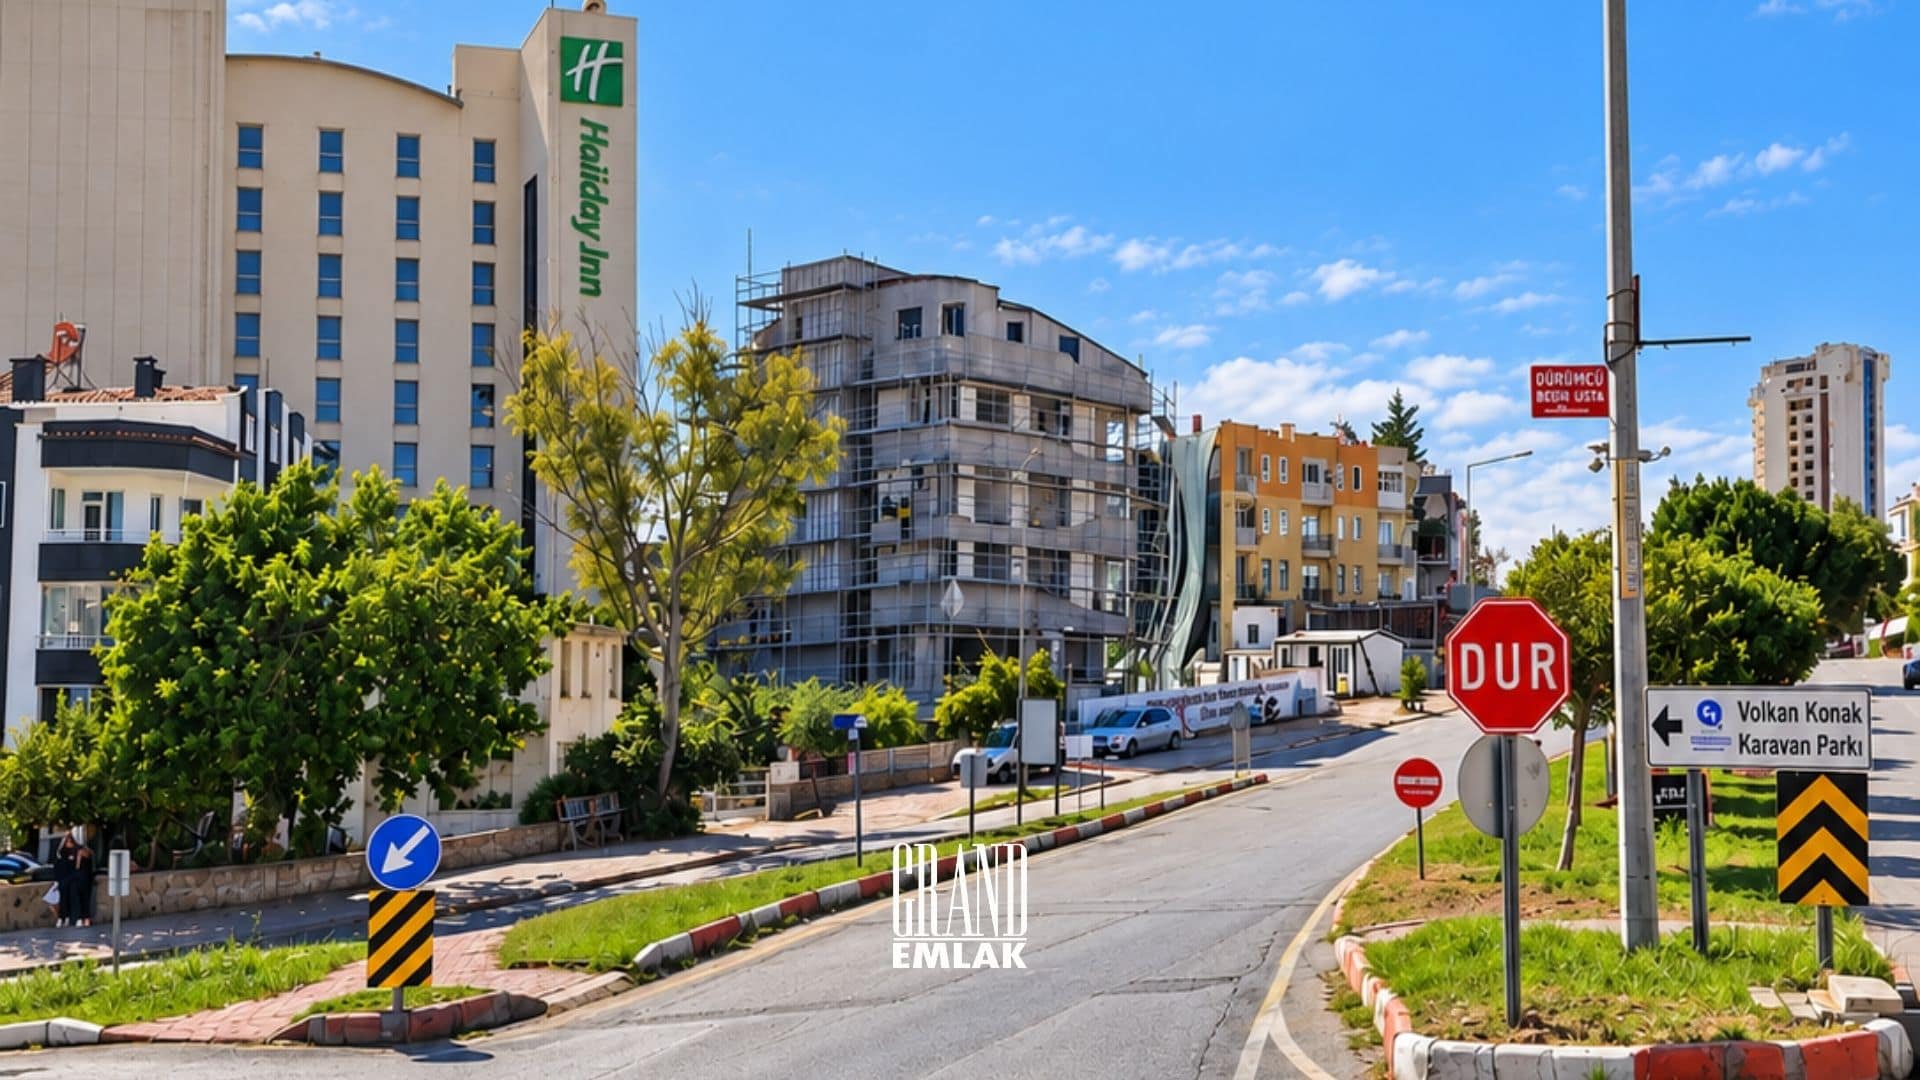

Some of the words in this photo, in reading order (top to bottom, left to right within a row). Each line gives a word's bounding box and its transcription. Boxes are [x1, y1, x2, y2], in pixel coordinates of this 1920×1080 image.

[579, 241, 609, 298] Inn
[1460, 642, 1558, 691] DUR
[1737, 700, 1799, 723] Volkan
[1805, 701, 1863, 724] Konak
[1738, 733, 1811, 756] Karavan
[1817, 734, 1863, 756] Parkı
